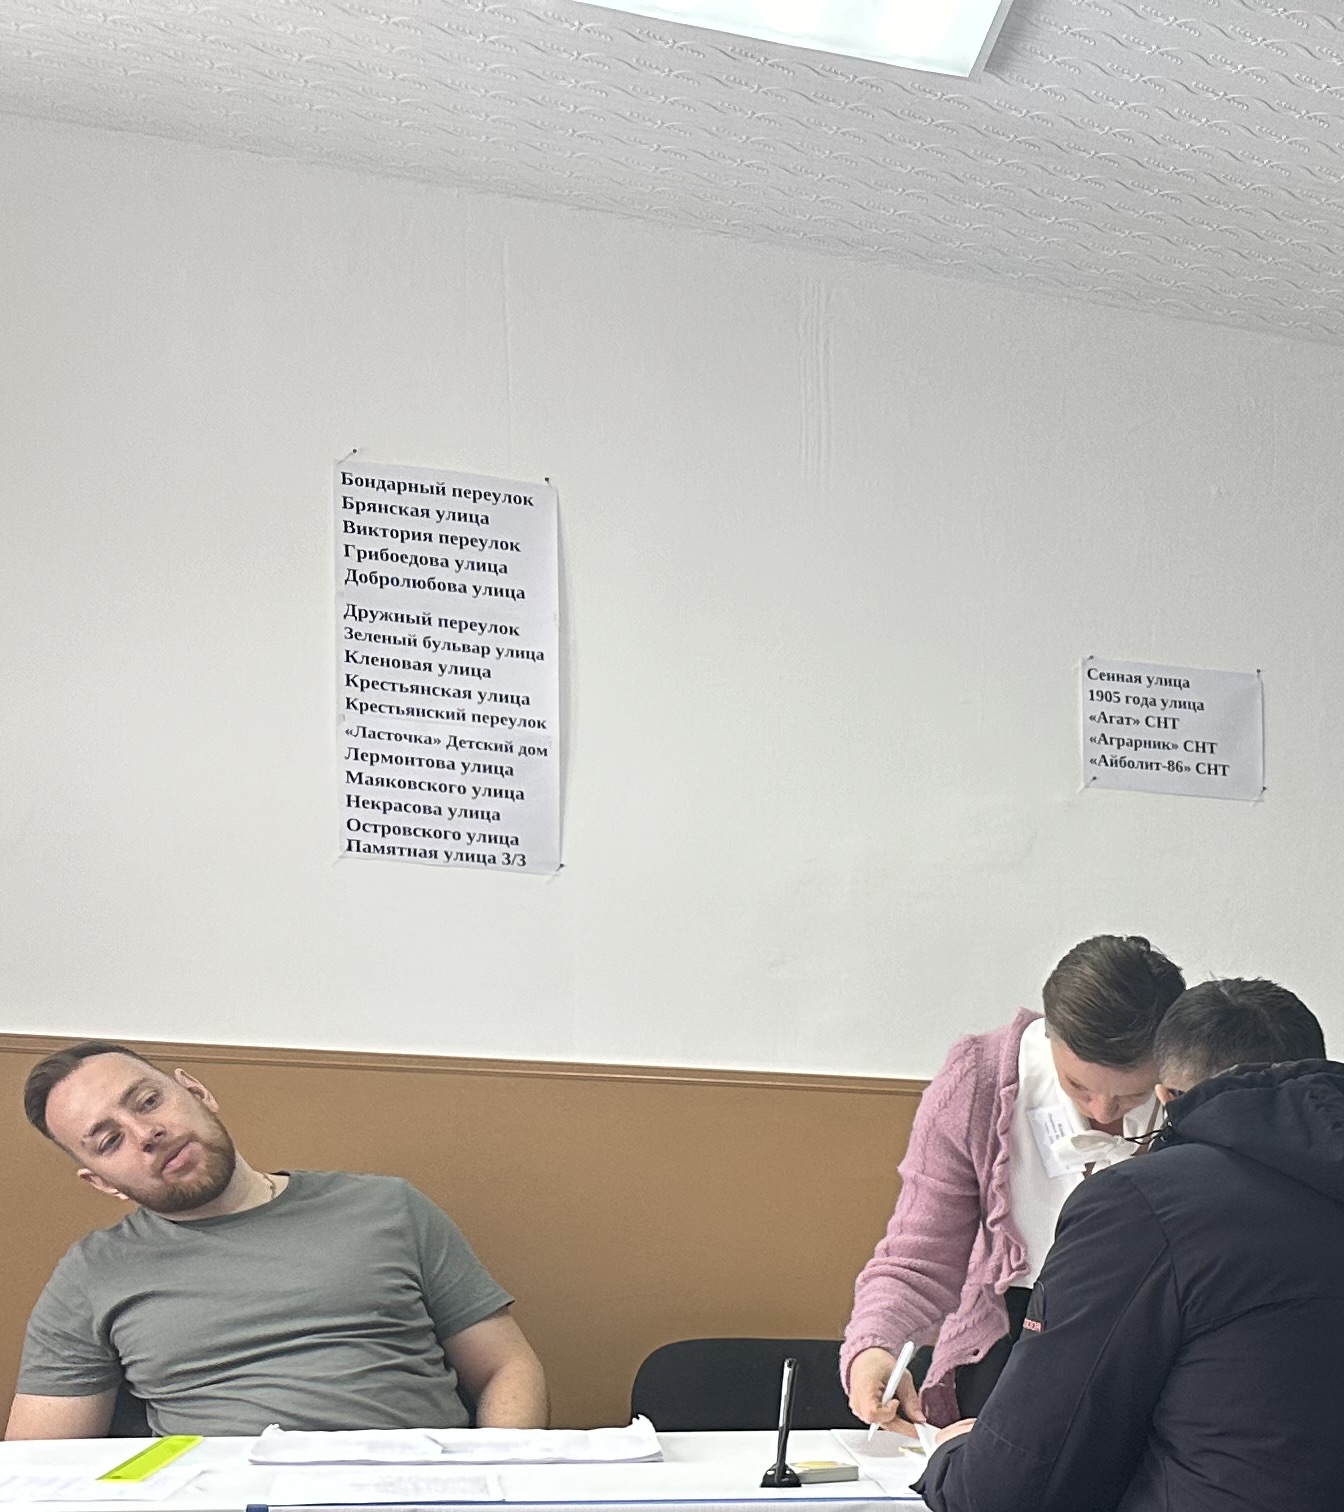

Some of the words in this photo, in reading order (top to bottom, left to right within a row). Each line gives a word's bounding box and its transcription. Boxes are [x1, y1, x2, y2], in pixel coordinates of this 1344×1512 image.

[340, 471, 446, 496] Бондарный
[452, 487, 534, 506] переулок
[341, 495, 430, 518] Брянская
[435, 509, 489, 527] улица
[342, 519, 433, 543] Виктория
[438, 533, 520, 552] переулок
[343, 543, 449, 568] Грибоедова
[454, 559, 507, 576] улица
[344, 567, 467, 594] Добролюбова
[472, 584, 525, 601] улица
[343, 603, 432, 626] Дружный
[438, 617, 519, 636] переулок
[344, 626, 417, 647] Зеленый
[422, 635, 490, 658] бульвар
[495, 646, 544, 662] улица
[344, 649, 432, 672] Кленовая
[438, 663, 491, 680] улица
[1087, 668, 1142, 684] Сенная
[1146, 675, 1190, 690] улица
[345, 673, 472, 700] Крестьянская
[477, 690, 530, 707] улица
[1089, 689, 1121, 703] 1905
[1125, 695, 1157, 709] года
[1160, 698, 1205, 713] улица
[345, 696, 466, 721] Крестьянский
[471, 713, 546, 729] переулок
[1088, 711, 1140, 726] «Агат»
[1144, 715, 1180, 730] СНТ
[344, 725, 441, 745] «Ласточка»
[445, 734, 513, 753] Детский
[517, 745, 547, 757] дом
[1089, 732, 1178, 751] «Аграрник»
[1183, 740, 1217, 754] СНТ
[344, 746, 455, 770] Лермонтова
[460, 761, 514, 778] улица
[1089, 754, 1191, 773] «Айболит-86»
[1195, 762, 1230, 776] СНТ
[345, 770, 466, 794] Маяковского
[471, 785, 525, 802] улица
[346, 794, 442, 816] Некрасова
[447, 806, 500, 823] улица
[346, 818, 461, 841] Островского
[466, 832, 519, 848] улица
[346, 838, 438, 859] Памятная
[443, 850, 496, 866] улица
[501, 852, 526, 867] 3/3
